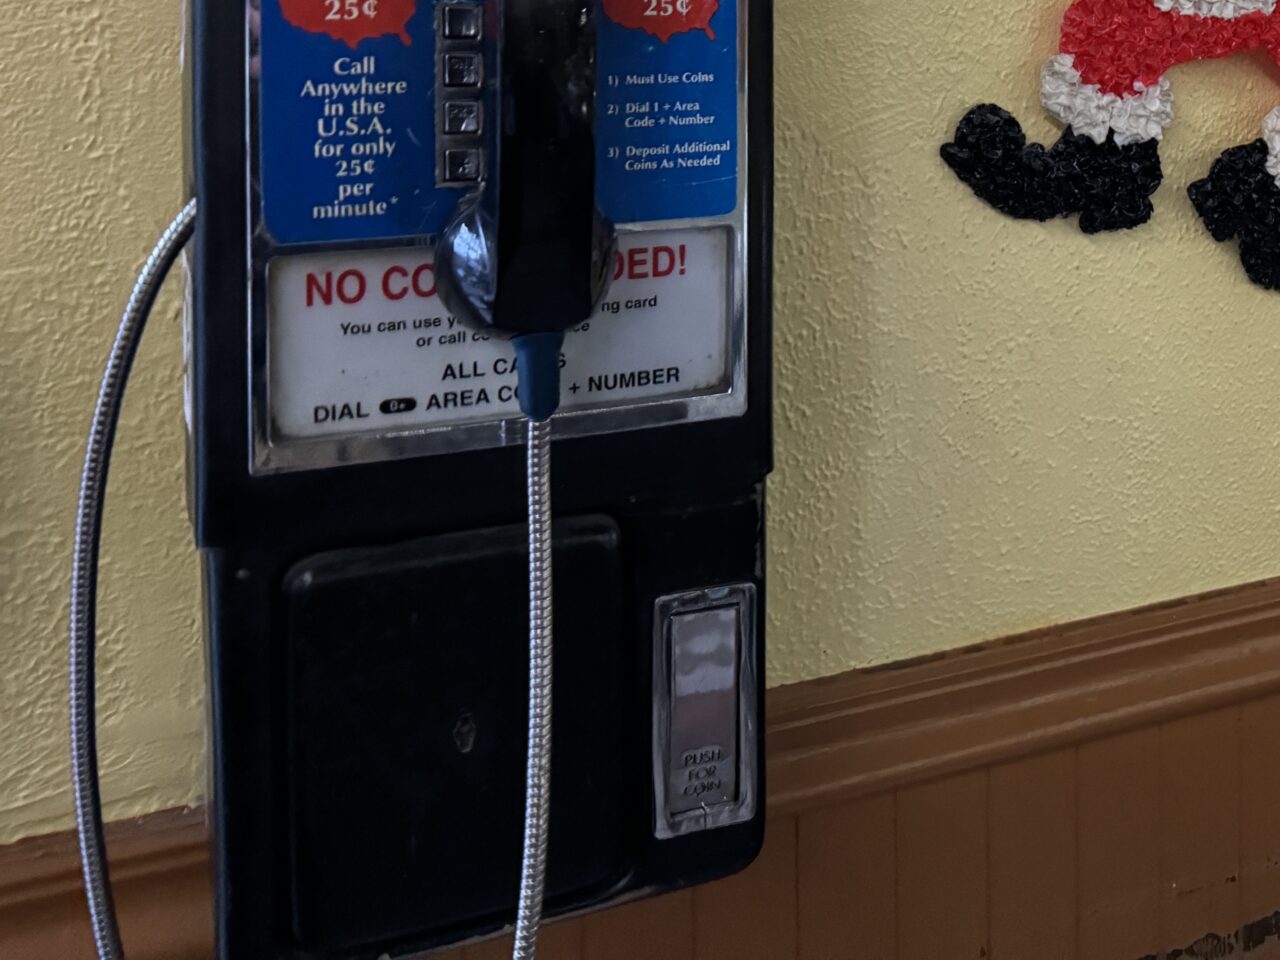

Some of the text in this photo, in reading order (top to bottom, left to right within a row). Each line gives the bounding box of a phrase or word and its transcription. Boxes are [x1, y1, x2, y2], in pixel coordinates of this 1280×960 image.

[333, 55, 376, 76] Call
[300, 76, 408, 101] Anywhere
[608, 71, 715, 88] 1) Must Use Coins
[323, 96, 386, 117] in the
[606, 104, 620, 116] 2)
[625, 101, 651, 115] Dial
[673, 100, 700, 112] Area
[316, 115, 393, 138] U.S.A.
[624, 114, 656, 129] Code
[668, 113, 716, 127] Number
[312, 135, 397, 159] for only
[607, 139, 731, 160] 3) Deposit Additional
[335, 158, 377, 178] 25¢
[624, 154, 721, 172] Coins As Needed
[337, 182, 375, 201] per
[305, 268, 367, 308] NO
[340, 321, 372, 336] You
[376, 319, 407, 333] can
[412, 316, 442, 330] use
[624, 295, 658, 310] card
[415, 336, 433, 348] or
[437, 331, 467, 346] call
[441, 360, 486, 382] ALL
[313, 401, 370, 424] DIAL
[425, 388, 491, 411] AREA
[569, 382, 581, 394] +
[587, 366, 680, 393] NUMBER
[684, 748, 721, 768] PUSH
[688, 765, 717, 782] FOR
[683, 779, 721, 797] COIN
